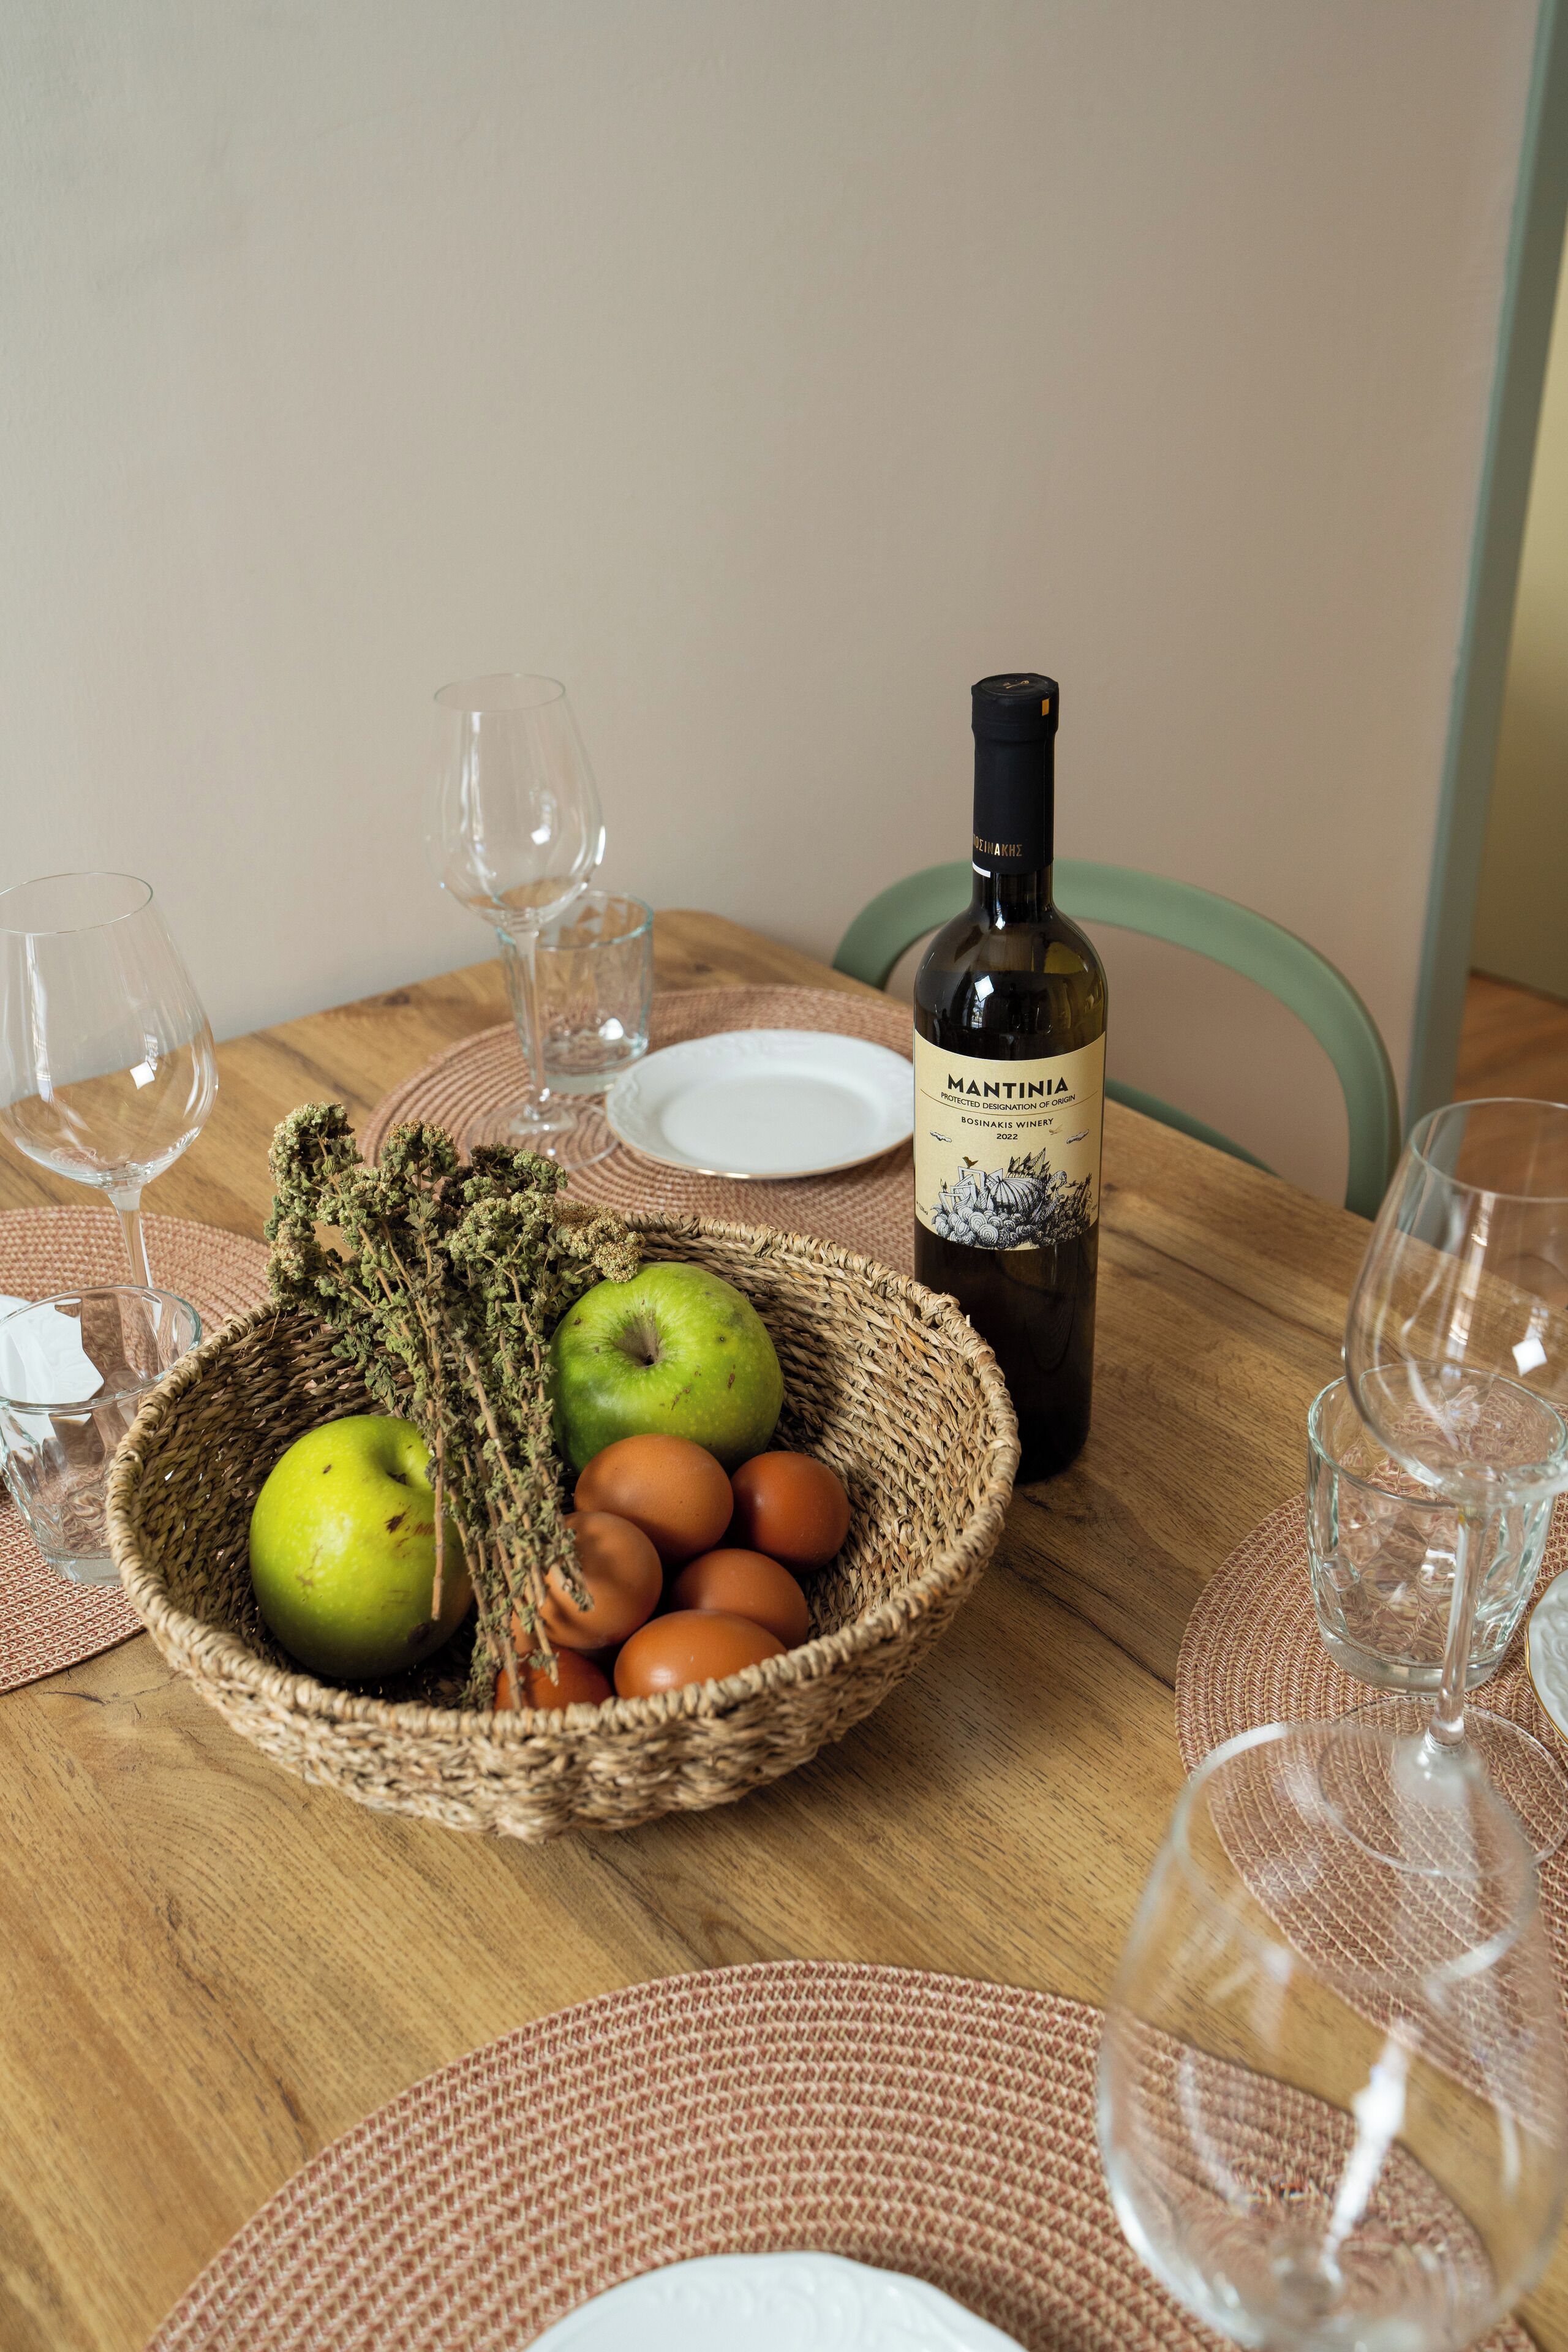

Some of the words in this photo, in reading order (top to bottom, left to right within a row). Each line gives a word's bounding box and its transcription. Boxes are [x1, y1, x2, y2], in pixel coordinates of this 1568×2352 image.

[948, 1073, 1068, 1098] MANTINIA
[941, 1092, 980, 1107] PROTECTED
[1052, 1094, 1076, 1106] ORIGIN
[961, 1117, 1012, 1128] BOSINAKIS
[1016, 1118, 1054, 1128] WINERY
